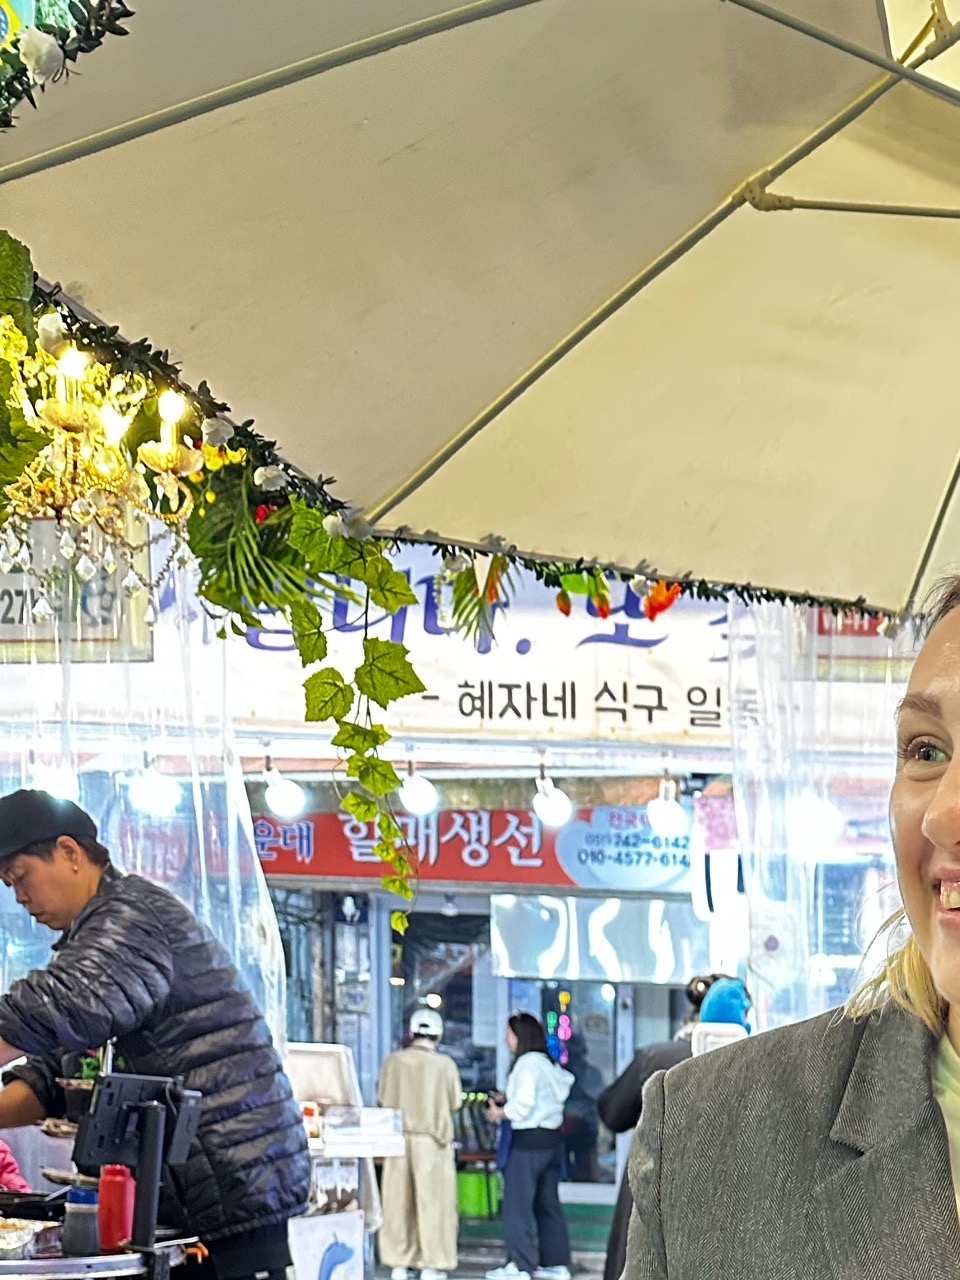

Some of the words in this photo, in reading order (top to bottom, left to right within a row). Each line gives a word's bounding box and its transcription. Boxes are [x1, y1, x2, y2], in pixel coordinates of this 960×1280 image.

[458, 680, 577, 720] 혜자네
[594, 681, 668, 723] 식구
[254, 819, 315, 864] 운대
[577, 848, 690, 867] 010-4577-614
